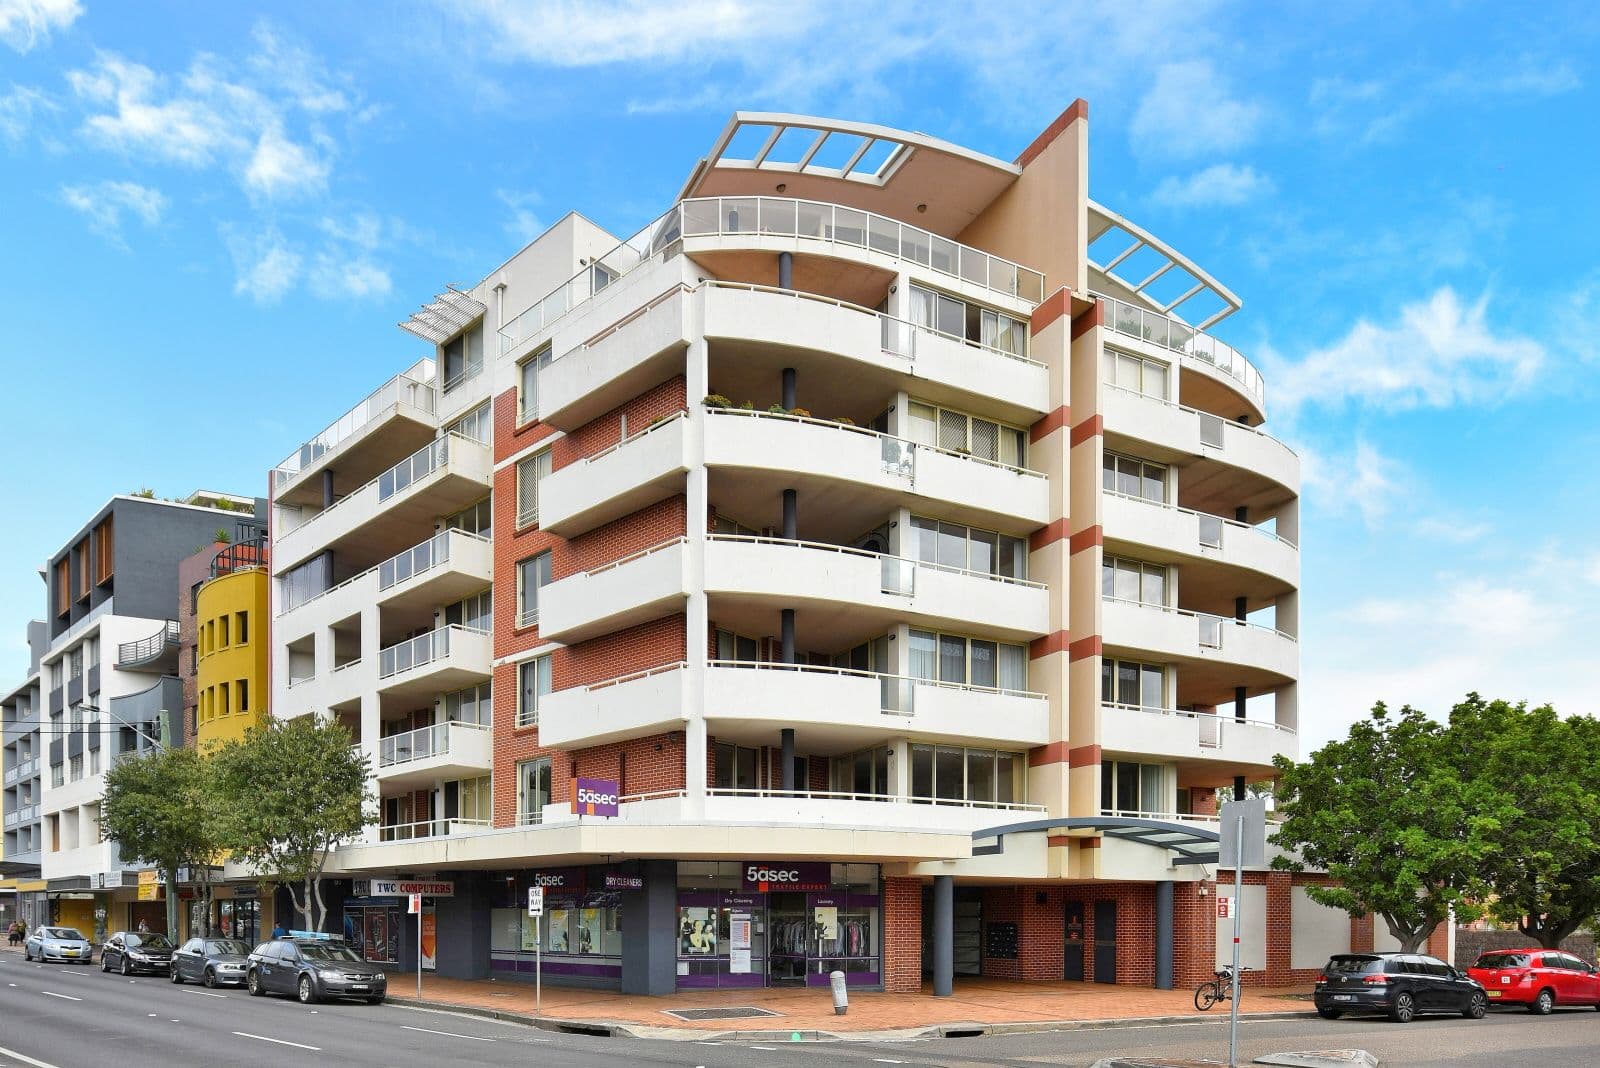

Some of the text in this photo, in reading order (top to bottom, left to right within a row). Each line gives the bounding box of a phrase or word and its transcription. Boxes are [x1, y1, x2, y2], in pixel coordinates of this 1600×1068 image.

[606, 877, 643, 887] DRY CLEANERS
[377, 883, 451, 894] TWC COMPUTERS
